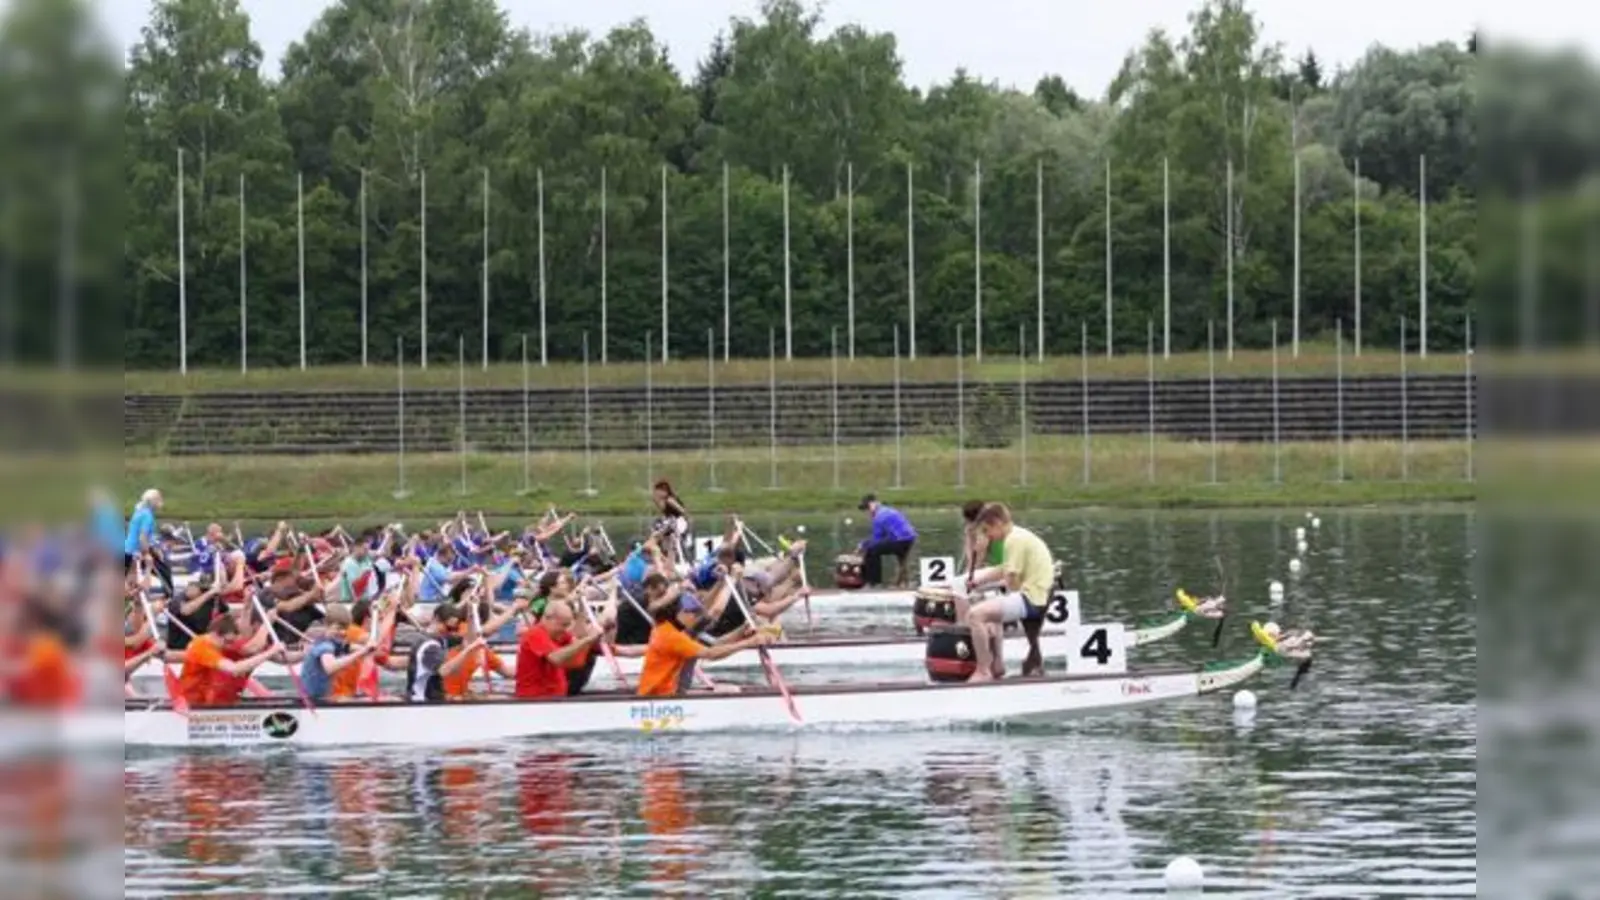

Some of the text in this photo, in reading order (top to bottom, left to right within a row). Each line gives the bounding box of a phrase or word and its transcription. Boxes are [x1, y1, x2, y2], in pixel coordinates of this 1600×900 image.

[929, 560, 946, 581] 2
[1046, 595, 1069, 623] 3
[1081, 629, 1112, 664] 4
